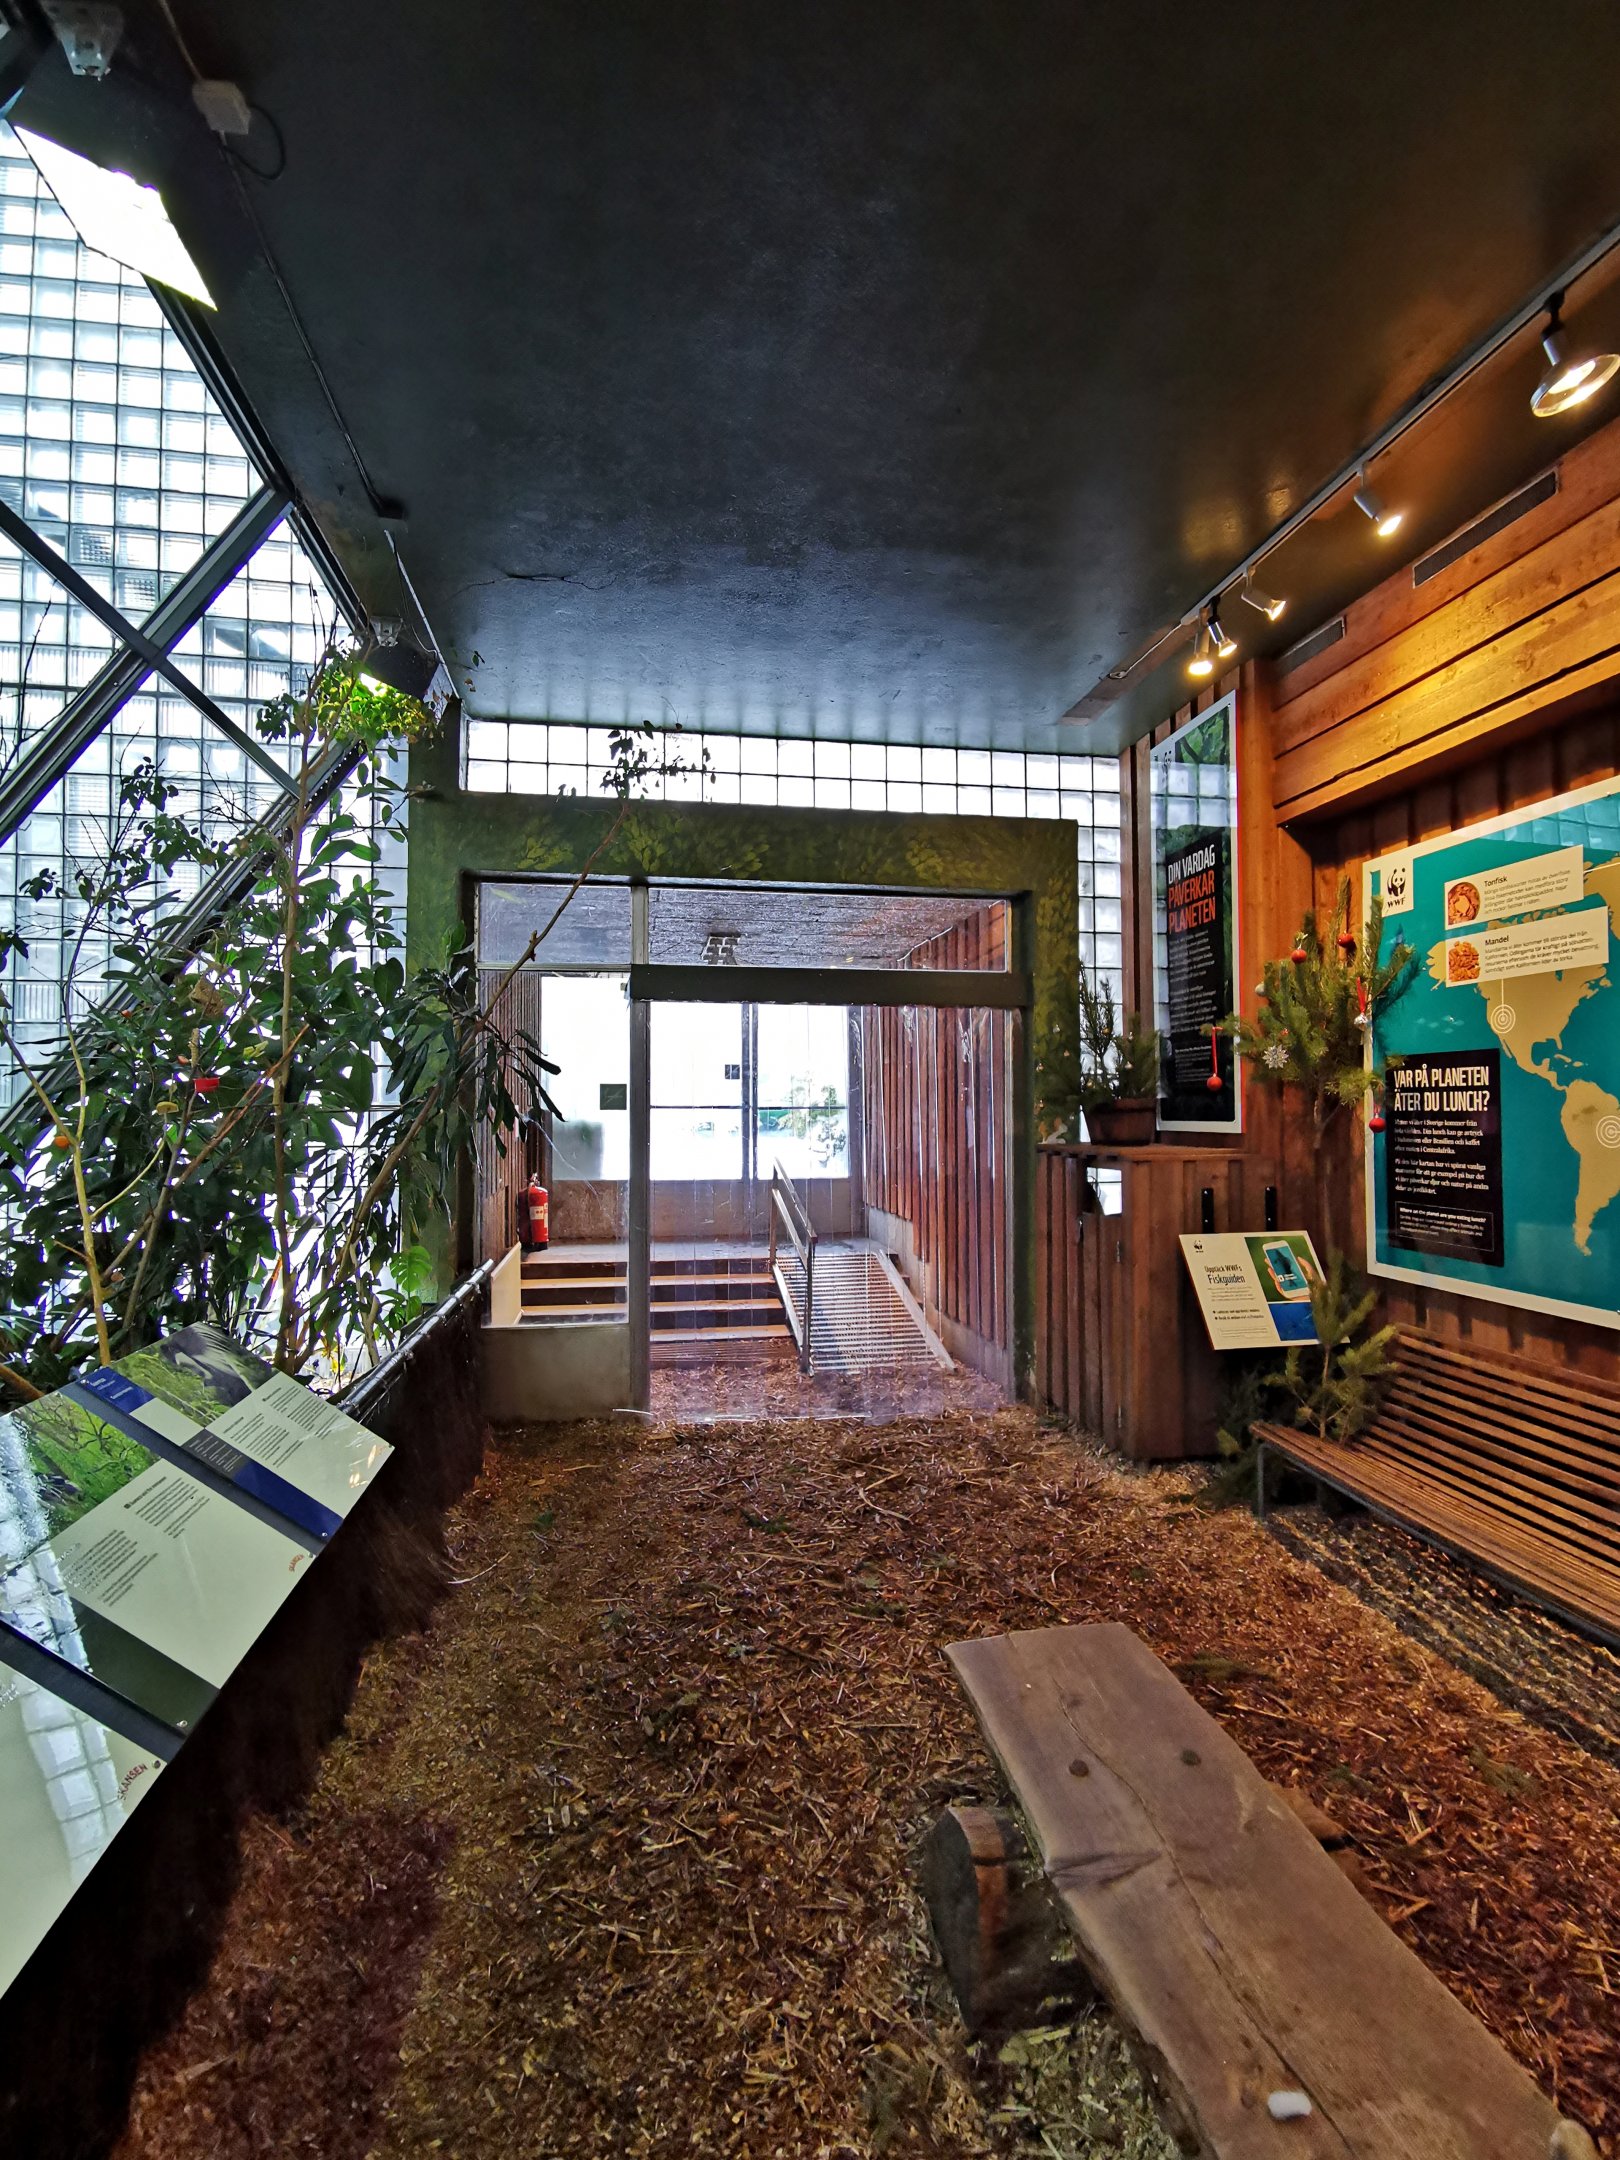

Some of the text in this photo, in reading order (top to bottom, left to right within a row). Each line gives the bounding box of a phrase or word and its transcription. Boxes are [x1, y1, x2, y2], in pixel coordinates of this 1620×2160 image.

[1168, 844, 1215, 884] DIN VARDAG
[1484, 875, 1508, 887] Tonfisk
[1169, 870, 1214, 909] PÅVERKAR
[1386, 896, 1405, 908] WWF
[1169, 896, 1215, 934] PLANETEN
[1485, 935, 1509, 945] Mandel
[1516, 960, 1540, 968] Kalifornien
[1394, 1064, 1489, 1088] VAR PÅ PLANETEN
[1394, 1088, 1490, 1111] ÄTER DU LUNCH?
[1437, 1170, 1457, 1178] exempel
[1204, 1265, 1225, 1274] Upptäck
[1208, 1274, 1245, 1286] Fiskguiden
[118, 1764, 148, 1800] SKANSEN
